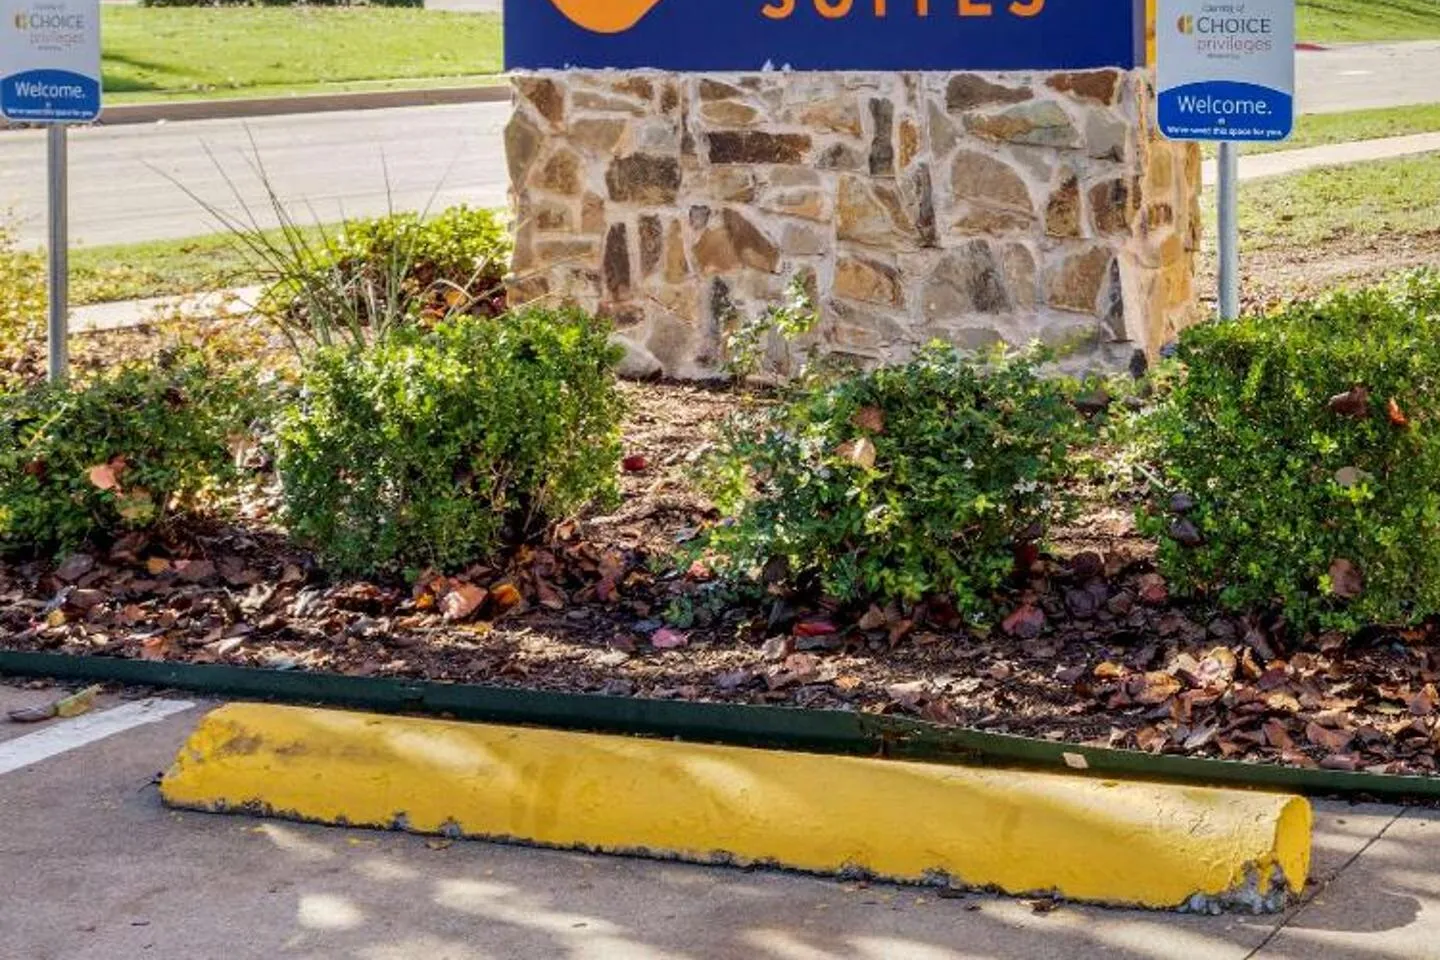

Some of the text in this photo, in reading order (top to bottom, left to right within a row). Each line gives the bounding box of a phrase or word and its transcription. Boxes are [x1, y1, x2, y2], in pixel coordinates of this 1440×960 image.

[1196, 17, 1272, 34] CHOICE
[1197, 35, 1273, 54] privileges
[14, 81, 86, 99] Welcome.
[1176, 95, 1273, 115] Welcome.
